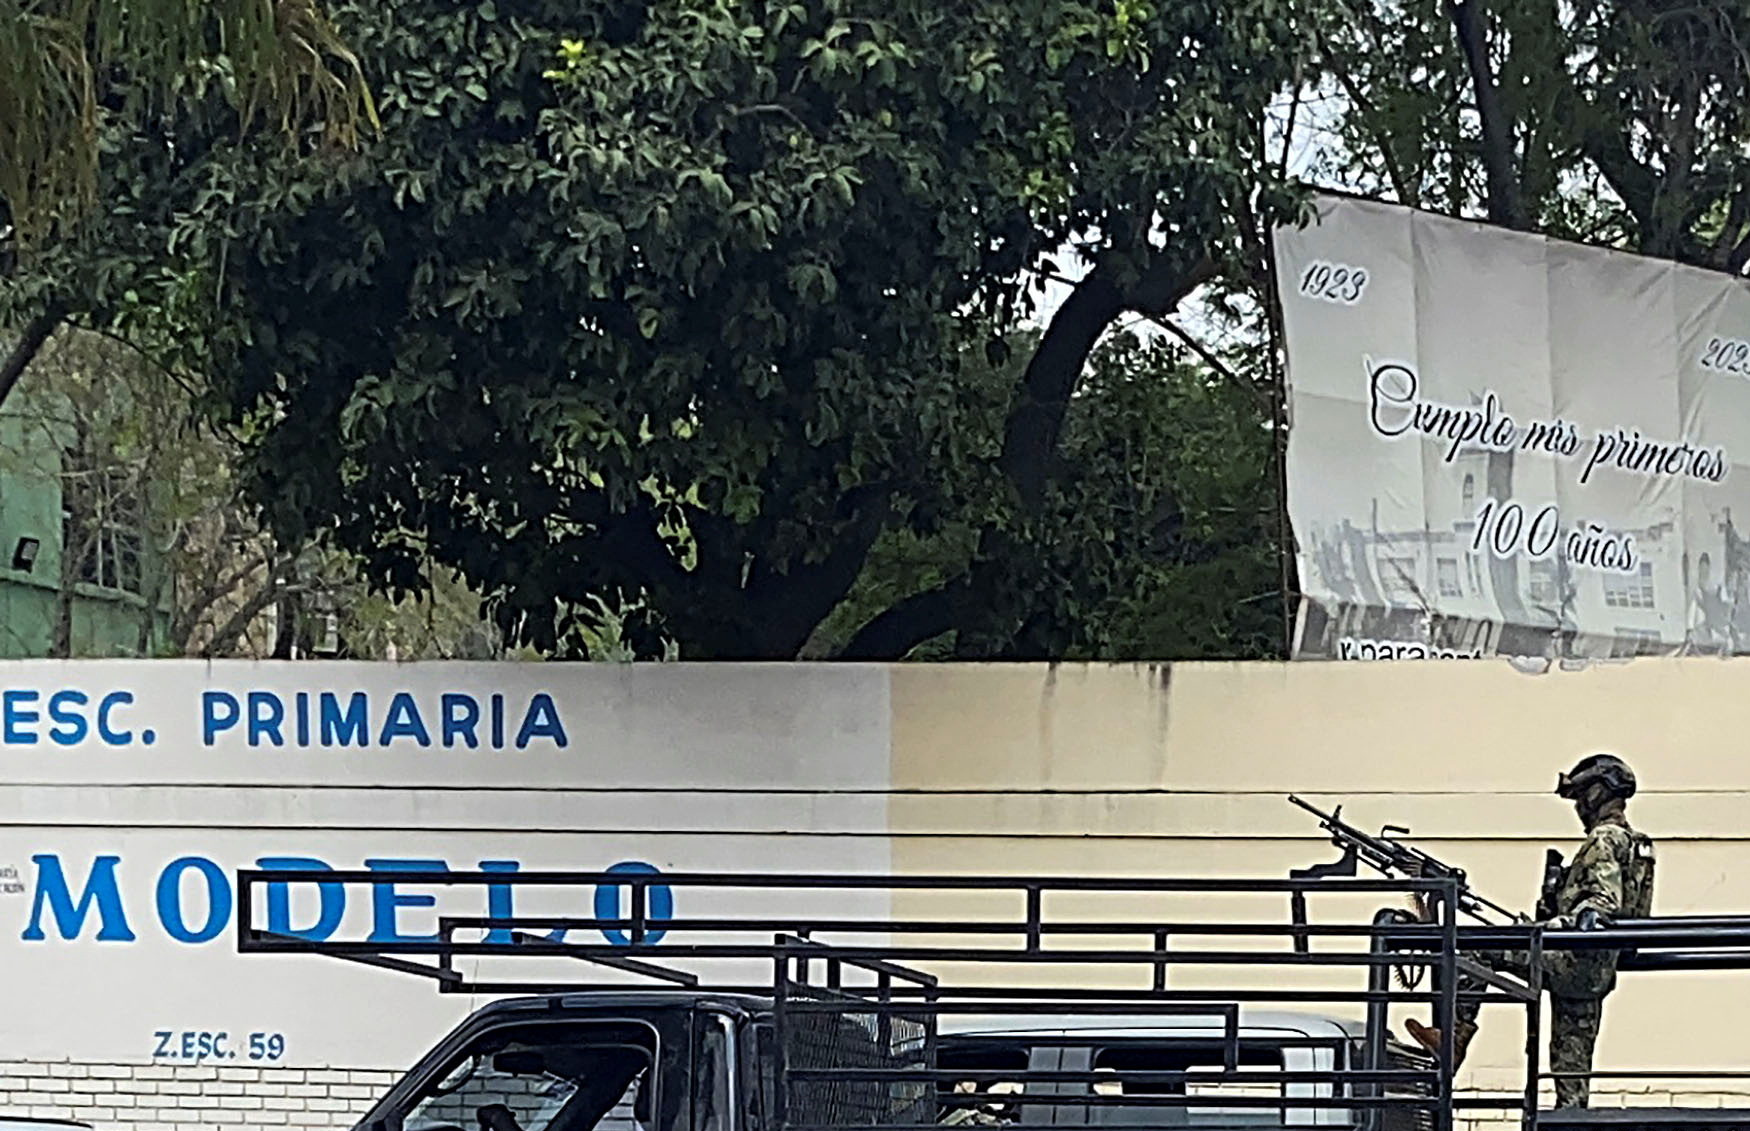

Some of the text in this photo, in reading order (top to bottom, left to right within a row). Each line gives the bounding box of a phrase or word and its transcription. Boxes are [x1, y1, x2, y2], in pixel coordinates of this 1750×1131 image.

[1301, 264, 1366, 301] 1923
[1521, 419, 1584, 456] mis
[1581, 430, 1728, 484] primeros
[1473, 503, 1638, 571] 100 años
[3, 687, 568, 749] ESC. PRIMARIA
[21, 854, 674, 945] MODELO
[152, 1031, 285, 1060] Z.ESC. 59
